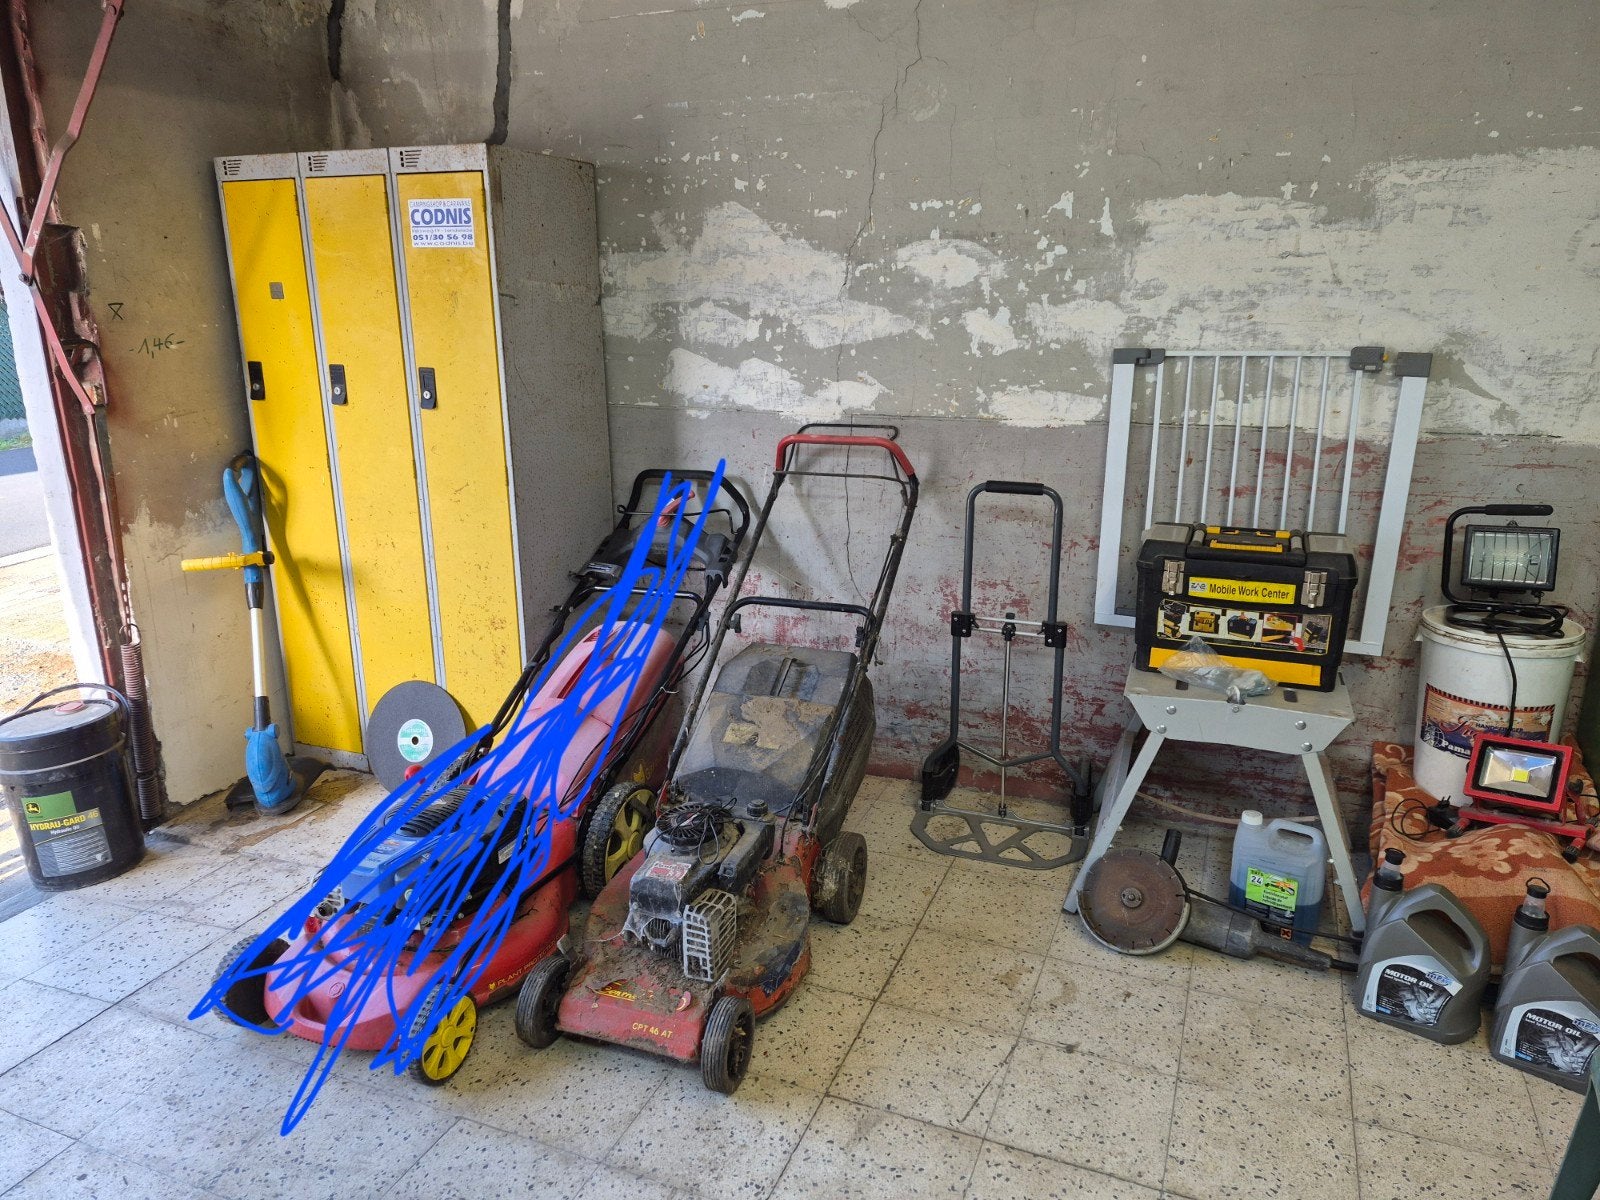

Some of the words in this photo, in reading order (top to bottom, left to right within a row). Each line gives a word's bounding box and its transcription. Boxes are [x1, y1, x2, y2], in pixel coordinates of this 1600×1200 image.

[411, 208, 472, 225] CODNIS
[1209, 583, 1237, 595] Mobile
[1238, 586, 1259, 597] Work
[1261, 587, 1290, 599] Center
[29, 814, 86, 831] HYDRAU-GARD
[87, 811, 99, 820] 46
[1250, 875, 1263, 885] 24
[497, 969, 523, 986] PLANT
[1384, 968, 1418, 984] MOTOR
[1418, 980, 1435, 991] OIL
[632, 1021, 649, 1033] CPT
[649, 1026, 659, 1036] 46
[660, 1029, 673, 1039] AT
[1526, 1012, 1564, 1031] MOTOR
[1564, 1027, 1582, 1038] OIL
